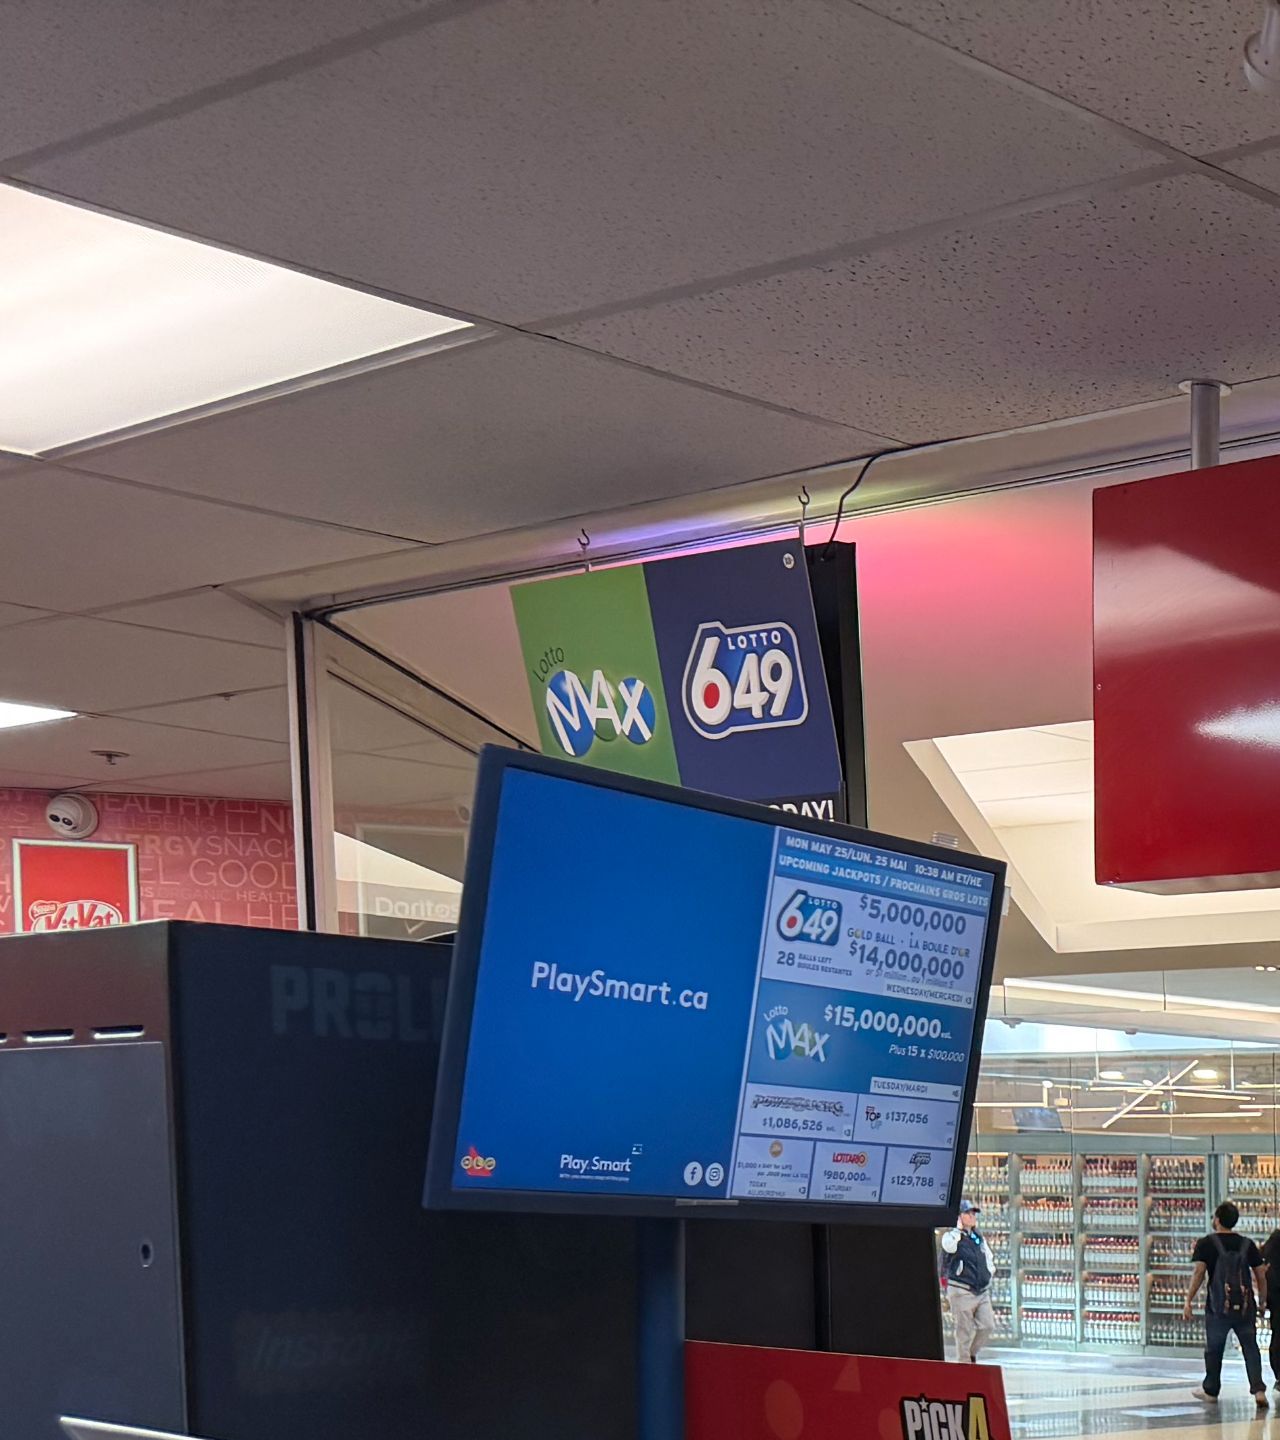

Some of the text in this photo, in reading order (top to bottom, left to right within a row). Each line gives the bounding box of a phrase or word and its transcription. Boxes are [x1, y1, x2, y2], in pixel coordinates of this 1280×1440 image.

[727, 630, 782, 650] LOTTO
[532, 645, 565, 683] Lotto
[691, 636, 794, 726] 649
[546, 669, 652, 756] MAX
[104, 794, 219, 815] EALTHY
[786, 836, 808, 850] MON
[811, 841, 832, 855] MAY
[875, 856, 888, 867] 25
[889, 859, 907, 872] MAI
[940, 869, 955, 882] AM
[779, 855, 830, 875] UPCOMING
[831, 867, 881, 886] JACKPOTS
[889, 879, 941, 898] PROCHAINS
[942, 889, 965, 903] GROS
[779, 893, 839, 944] 649
[807, 898, 839, 909] LOTTO
[859, 893, 966, 935] $5,000,000
[847, 927, 872, 941] GOLD
[875, 932, 896, 946] BALL
[909, 936, 921, 950] LA
[922, 939, 948, 954] BOULE
[776, 951, 796, 967] 28
[848, 940, 964, 980] $14,000,000
[530, 960, 708, 1010] PlaySmart.ca
[763, 1005, 789, 1022] Lotto
[823, 1004, 942, 1039] $15,000,000
[765, 1018, 830, 1063] MAX
[889, 1043, 907, 1056] Plus
[907, 1045, 918, 1056] 15
[927, 1047, 965, 1063] $100,000
[762, 1116, 823, 1132] $1,086,526
[885, 1111, 929, 1125] $137,056
[823, 1169, 866, 1182] $980,000
[890, 1176, 935, 1188] $129,788
